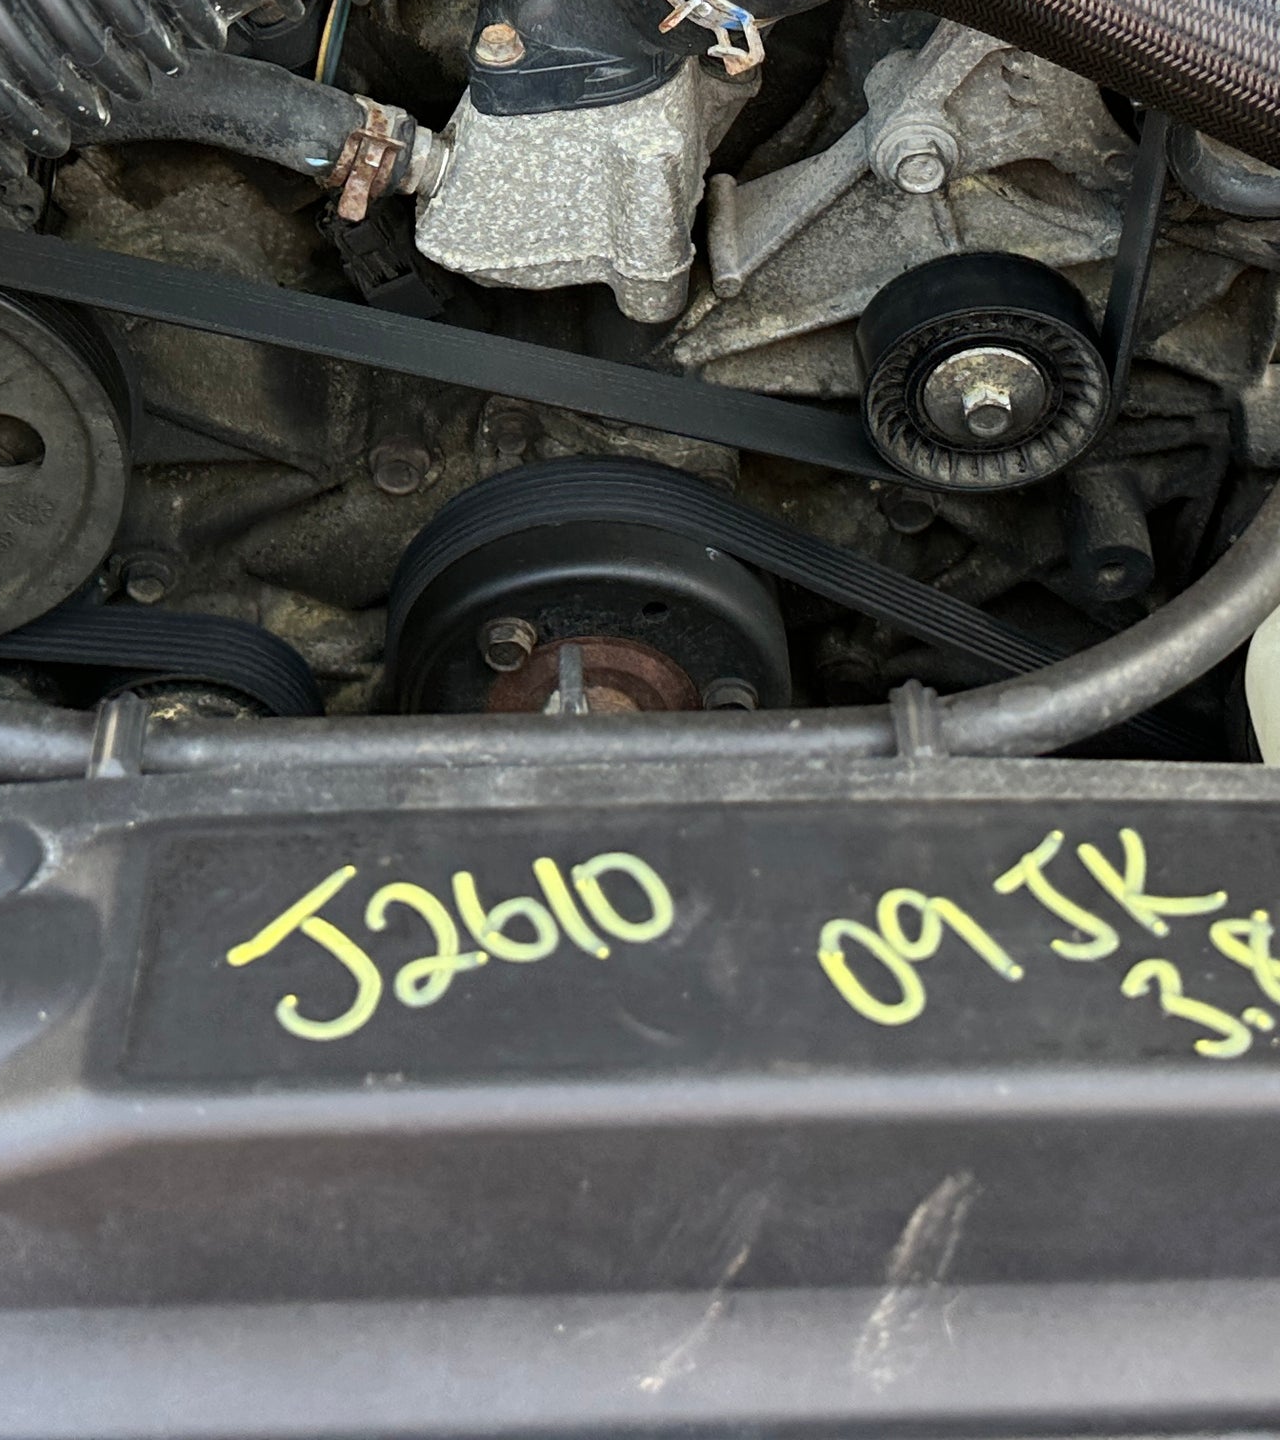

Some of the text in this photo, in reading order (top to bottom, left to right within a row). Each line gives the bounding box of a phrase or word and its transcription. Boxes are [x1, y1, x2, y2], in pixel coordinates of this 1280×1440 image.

[226, 828, 1227, 1038] J2610 09 JK
